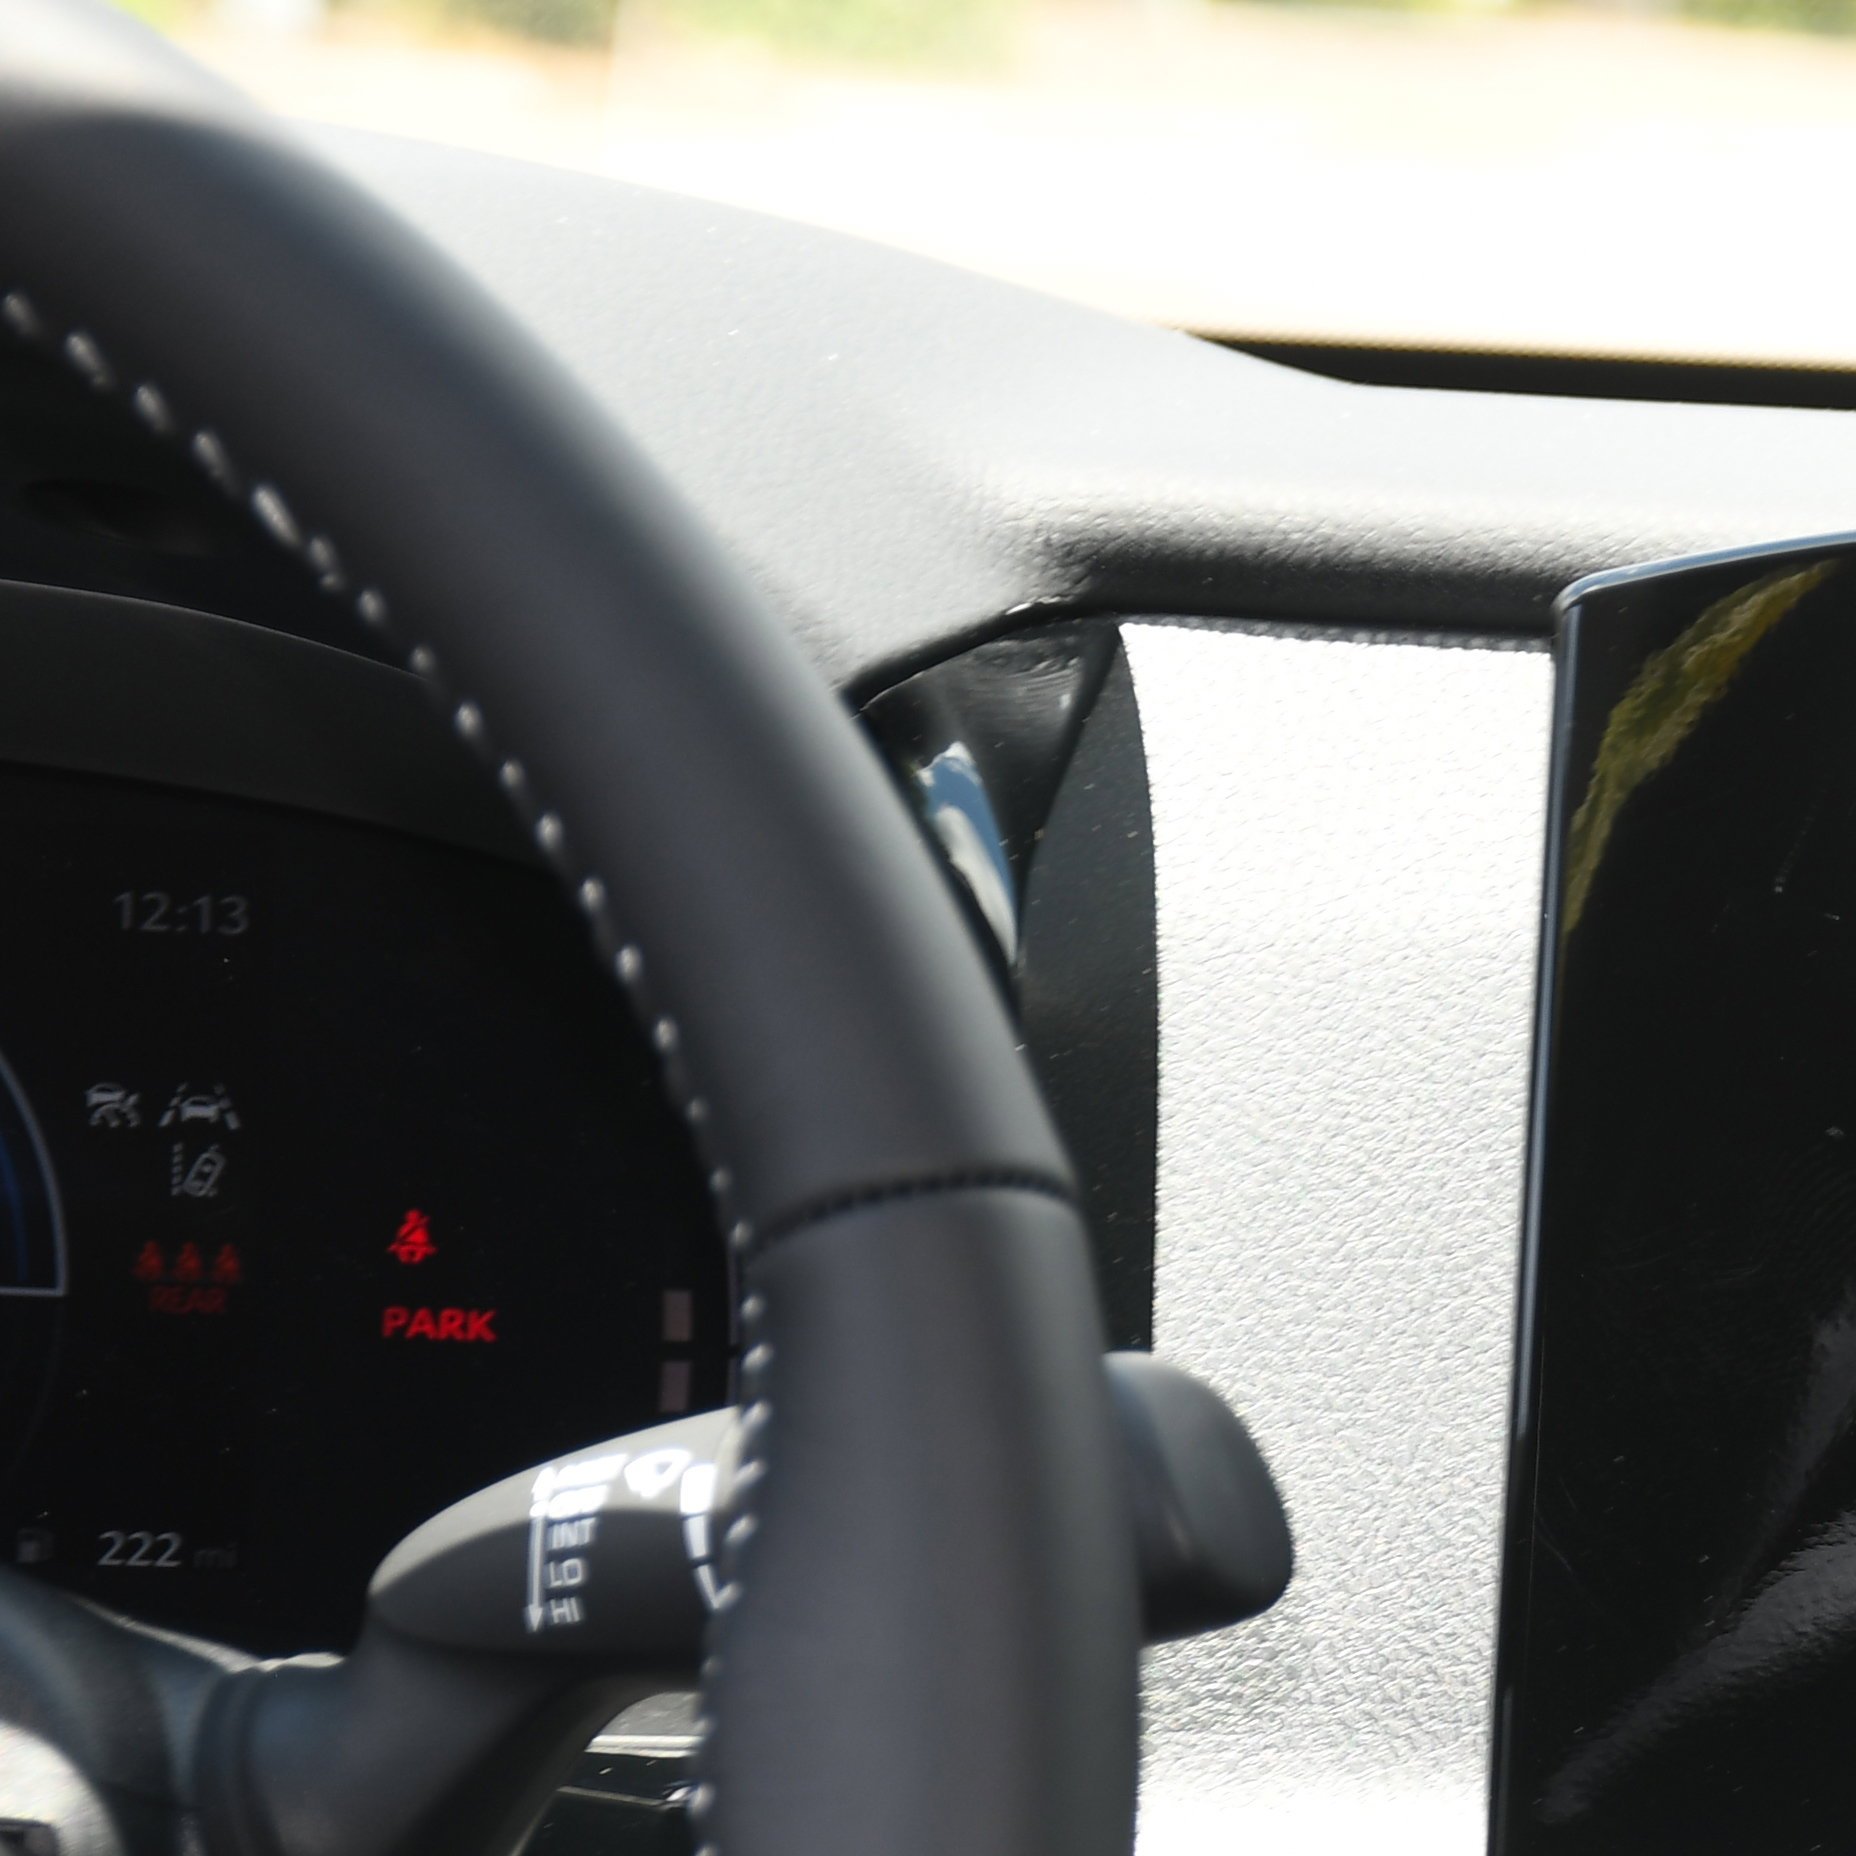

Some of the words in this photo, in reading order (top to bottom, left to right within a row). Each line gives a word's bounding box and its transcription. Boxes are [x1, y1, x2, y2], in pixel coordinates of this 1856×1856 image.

[112, 890, 251, 935] 12:13
[382, 1306, 498, 1342] PARK
[96, 1529, 184, 1568] 222
[548, 1517, 597, 1550] INT
[546, 1558, 586, 1588] LO
[546, 1596, 583, 1624] HI
